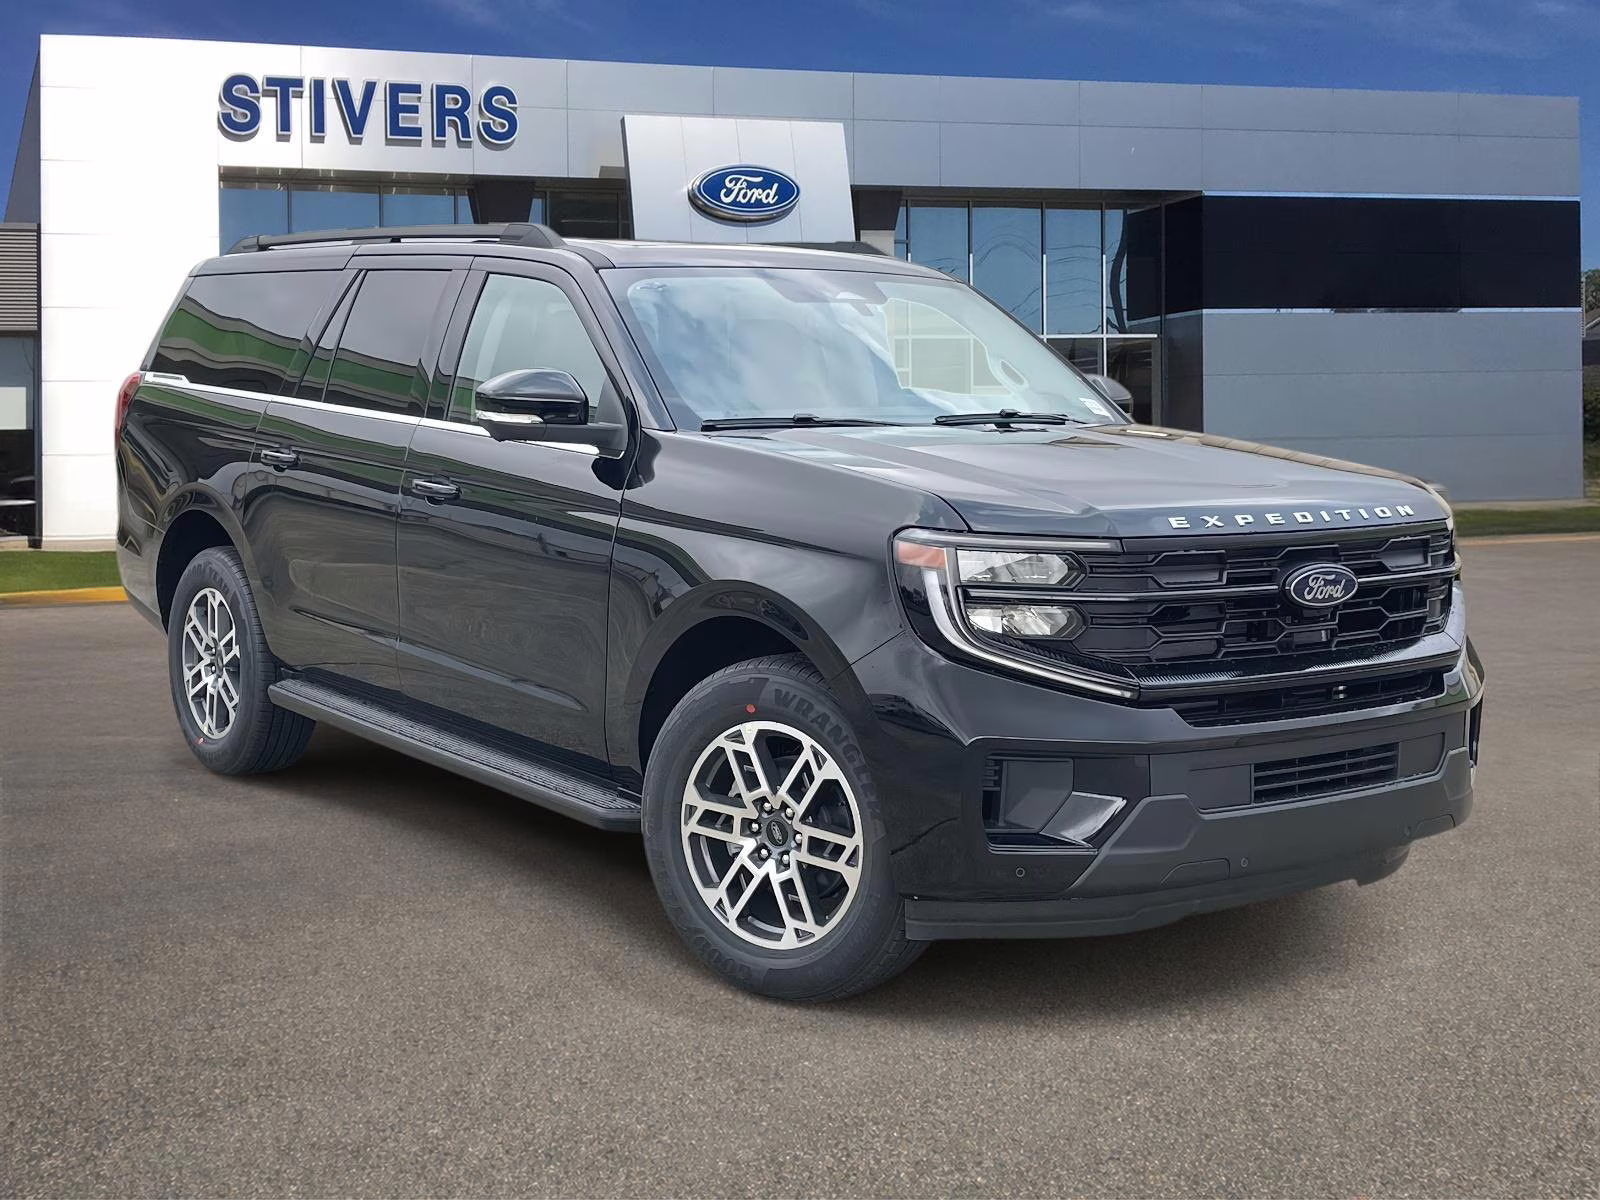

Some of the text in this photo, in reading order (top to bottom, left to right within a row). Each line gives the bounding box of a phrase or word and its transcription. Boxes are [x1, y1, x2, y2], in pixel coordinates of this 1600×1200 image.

[219, 73, 519, 146] STIVERS
[720, 174, 779, 204] Ford
[1168, 504, 1415, 529] EXPEDITION
[1303, 574, 1346, 601] Ford
